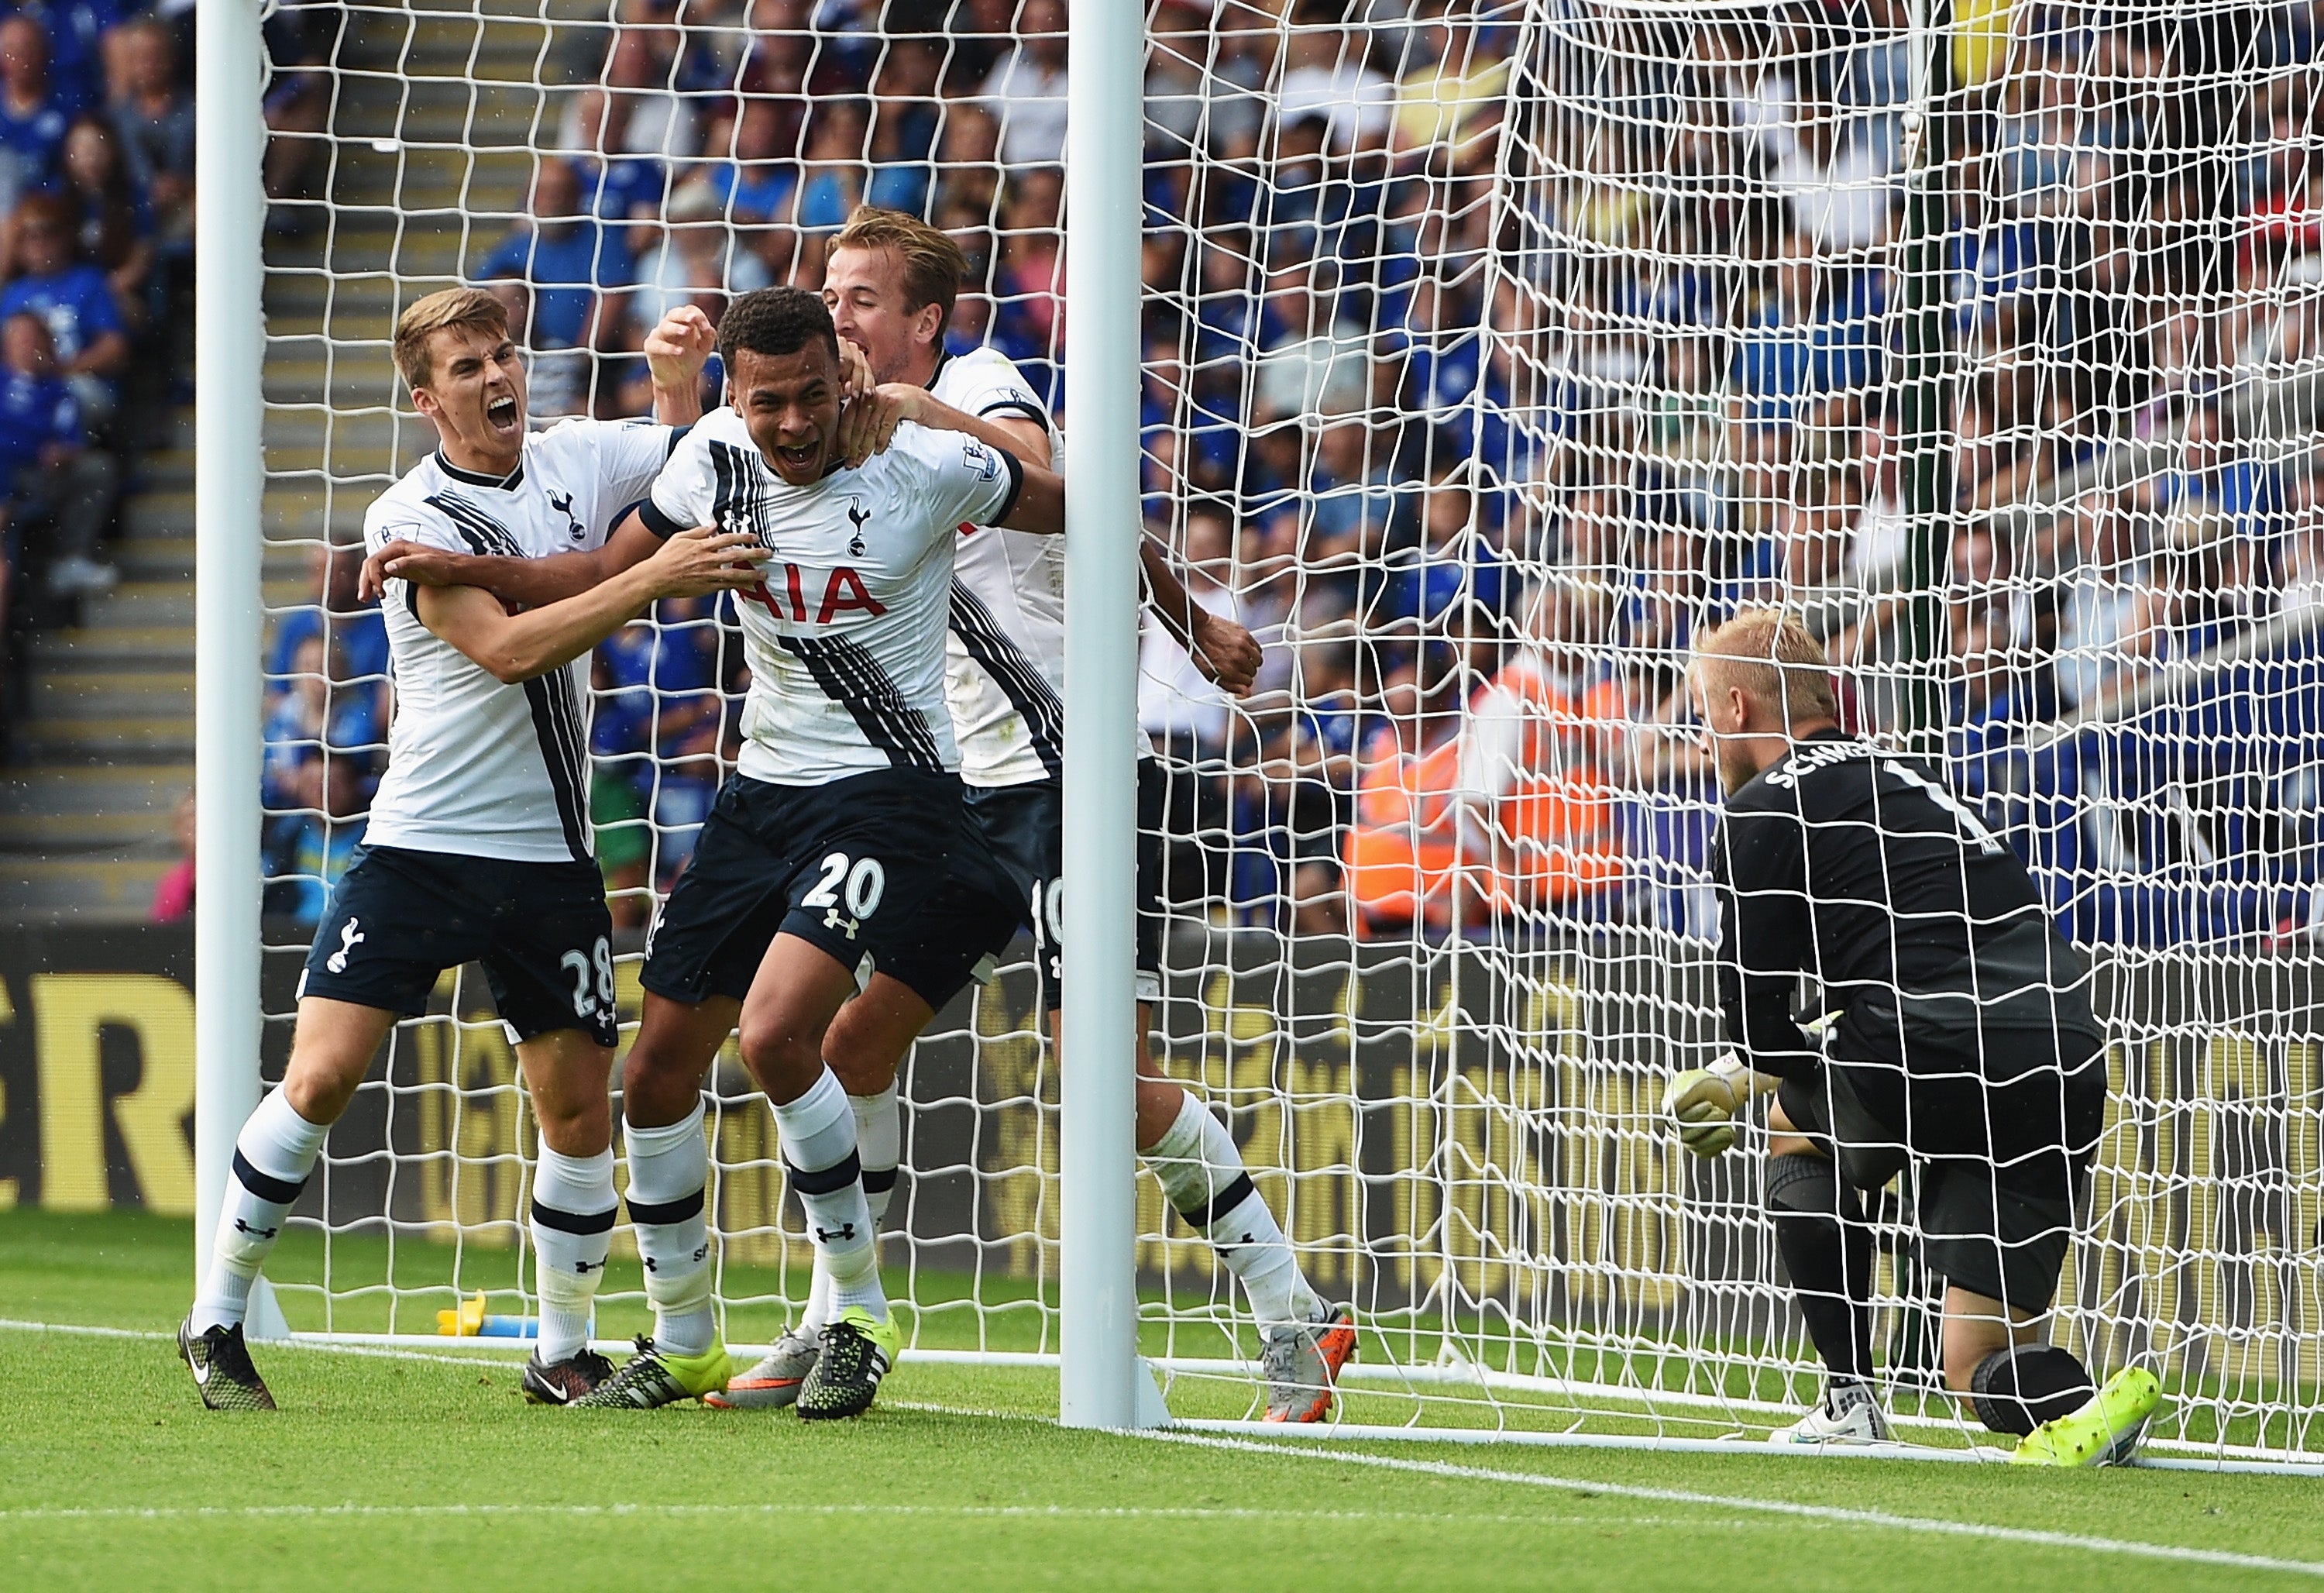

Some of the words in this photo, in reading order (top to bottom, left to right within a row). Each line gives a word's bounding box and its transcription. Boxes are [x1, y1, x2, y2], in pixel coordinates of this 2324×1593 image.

[731, 559, 889, 624] AIA
[1882, 759, 2006, 856] 1
[801, 852, 885, 920] 20
[559, 934, 614, 1019] 28
